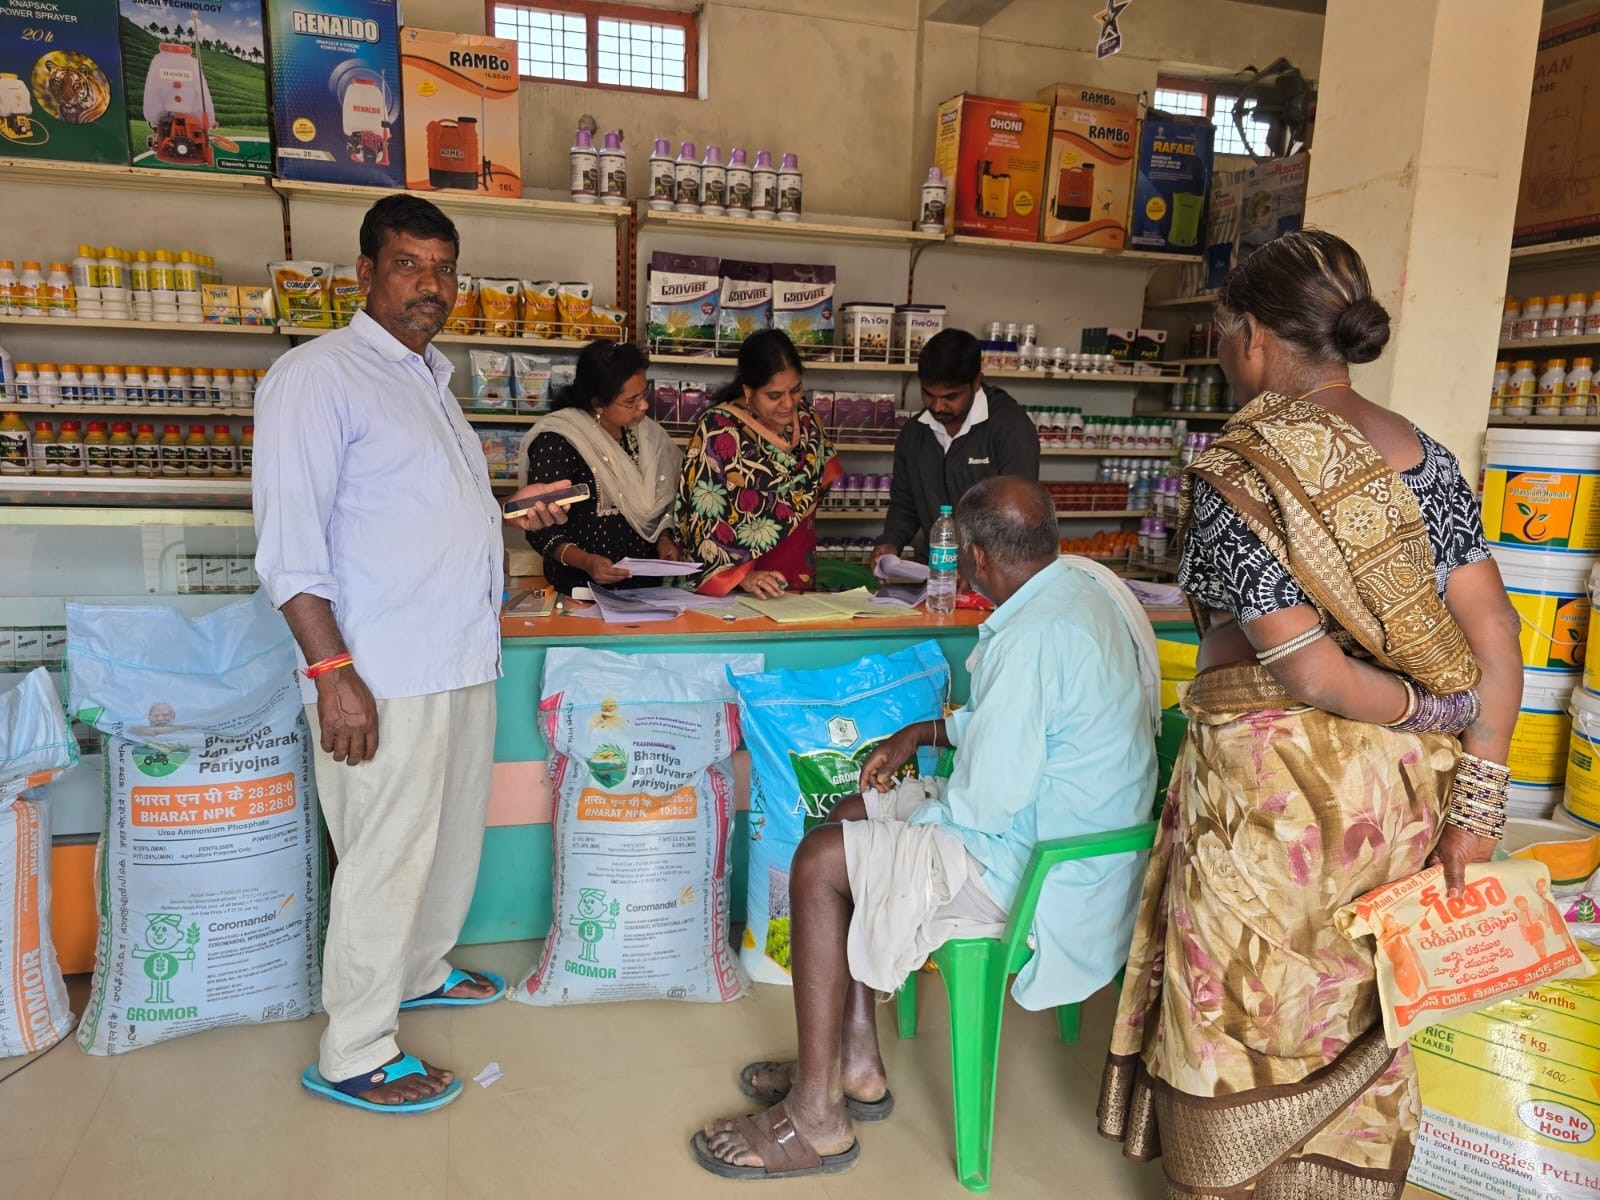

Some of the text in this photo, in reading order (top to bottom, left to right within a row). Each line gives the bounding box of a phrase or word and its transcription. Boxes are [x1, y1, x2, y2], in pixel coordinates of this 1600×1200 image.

[10, 0, 59, 11] KNAPSACK
[163, 0, 222, 13] TECHNOLOGY
[0, 8, 78, 23] POWER SPRAYER
[294, 12, 379, 42] RENALDO
[1533, 55, 1574, 80] AAN
[990, 118, 1022, 132] DHONI
[1153, 141, 1196, 155] RAFAEL
[876, 317, 888, 326] Ora
[911, 320, 939, 328] Five Ora
[199, 756, 279, 774] Pariyojna
[634, 751, 681, 766] Bhartiya
[632, 766, 653, 776] Jan
[833, 771, 861, 785] GROM
[135, 781, 293, 806] भारत एन पी के 28:28:0
[140, 796, 294, 822] BHARAT NPK 28:28:0
[793, 790, 853, 818] AKS
[178, 825, 225, 835] Ammonium
[227, 820, 270, 831] Phosphate
[30, 826, 38, 876] BHARAT
[1370, 866, 1442, 910] Main Road, Toop
[626, 900, 677, 913] Coromandel
[208, 910, 276, 932] Coromandel
[565, 960, 616, 979] GROMOR
[1528, 990, 1576, 1010] Months
[126, 1006, 198, 1022] GROMOR
[1425, 1026, 1455, 1044] RICE
[1422, 1037, 1454, 1055] TAXES)
[1530, 1037, 1550, 1052] kg.
[1533, 1106, 1588, 1131] Use No
[1448, 1118, 1455, 1128] &
[1457, 1120, 1500, 1142] Marketed
[1503, 1135, 1514, 1147] by
[1539, 1122, 1579, 1142] Hook
[1421, 1120, 1536, 1171] Technologies
[1434, 1140, 1452, 1152] 2008
[1454, 1148, 1490, 1166] CERTIFIED
[1491, 1161, 1533, 1181] COMPANY)
[1425, 1157, 1483, 1186] Karimnagar
